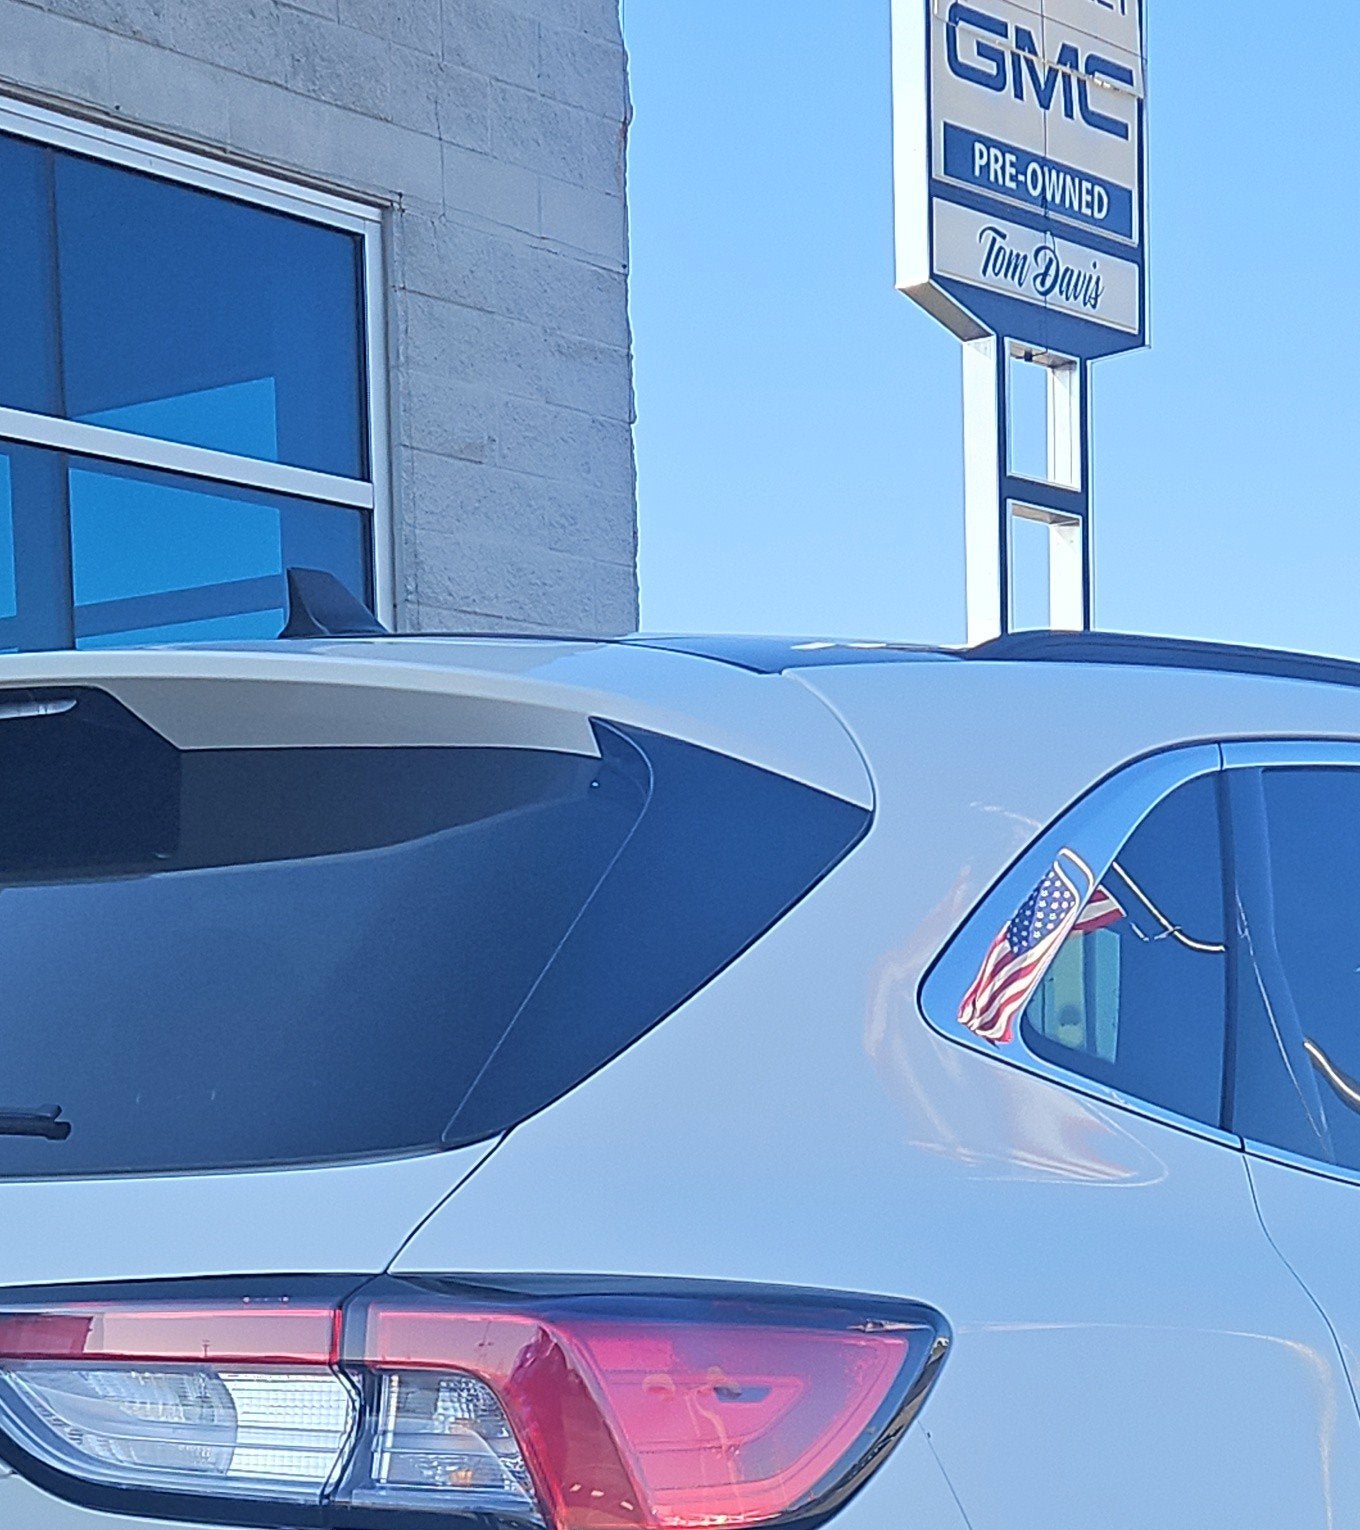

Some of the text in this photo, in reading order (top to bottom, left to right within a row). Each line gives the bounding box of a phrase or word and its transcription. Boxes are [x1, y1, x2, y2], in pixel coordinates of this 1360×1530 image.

[946, 2, 1134, 141] GMC
[973, 141, 1109, 220] PRE-OWNED
[979, 226, 1104, 310] Tom Davis
